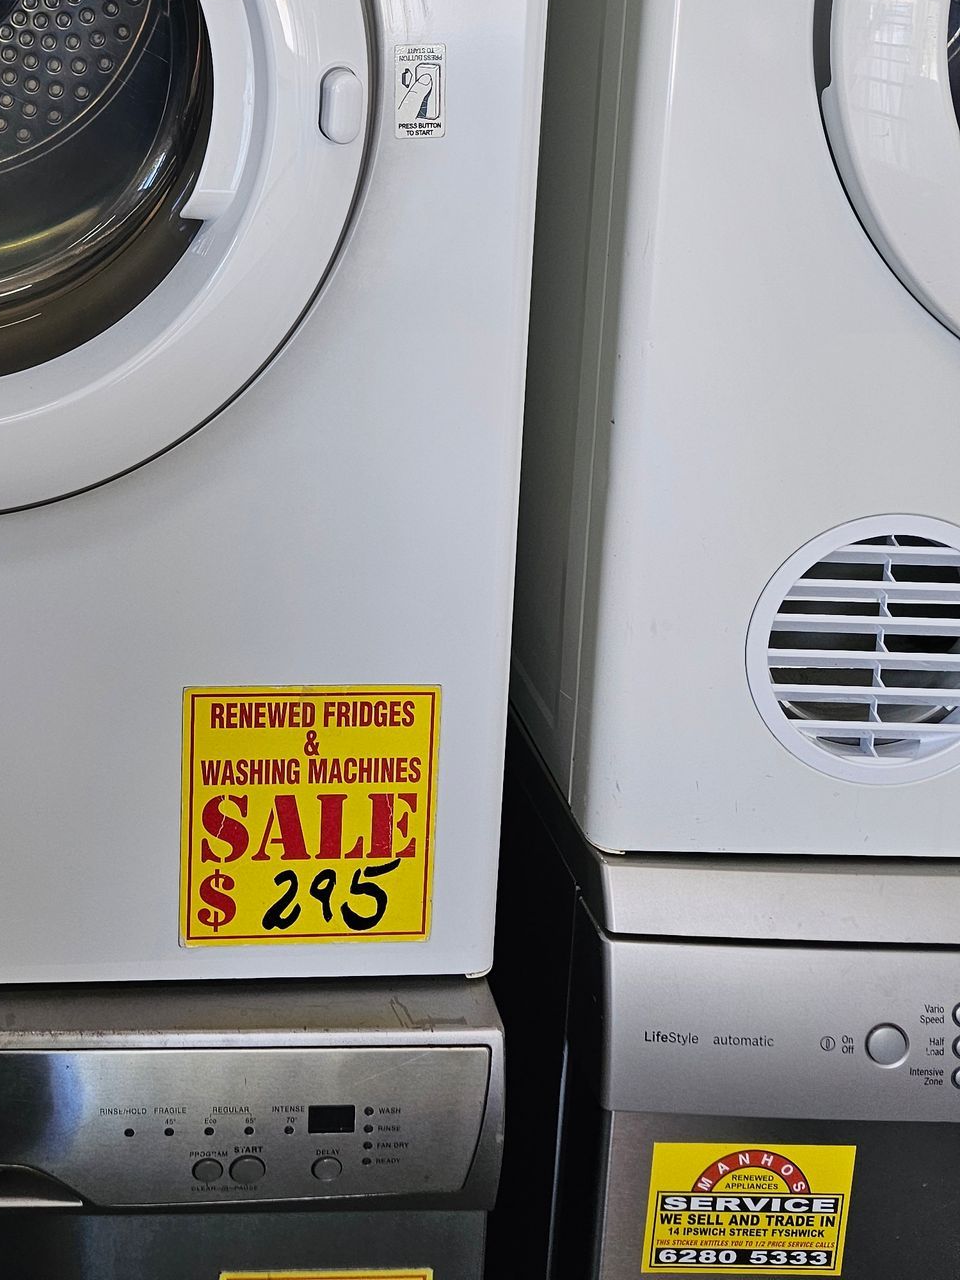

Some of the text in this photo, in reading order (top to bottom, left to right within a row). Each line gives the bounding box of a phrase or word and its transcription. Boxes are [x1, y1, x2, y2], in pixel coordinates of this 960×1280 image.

[210, 701, 415, 728] RENEWED FRIDGES
[304, 730, 320, 756] &
[201, 757, 421, 785] WASHING MACHINES
[201, 793, 418, 863] SALE
[197, 858, 401, 932] $ 295
[924, 1004, 945, 1014] Vario
[920, 1015, 945, 1025] Speed
[644, 1031, 774, 1047] LifeStyle automatic
[842, 1035, 854, 1044] On
[929, 1037, 944, 1046] Half
[842, 1045, 854, 1054] Off
[926, 1048, 944, 1056] Load
[909, 1068, 944, 1076] Intensive
[924, 1078, 943, 1086] Zone
[234, 1146, 263, 1154] START
[698, 1152, 805, 1192] MANHOS
[663, 1196, 835, 1212] SERVICE
[660, 1214, 835, 1227] WE SELL AND TRADE IN
[668, 1227, 825, 1237] 14 IPSWICH STREET FYSHWICK
[659, 1249, 828, 1265] 6280 5333
